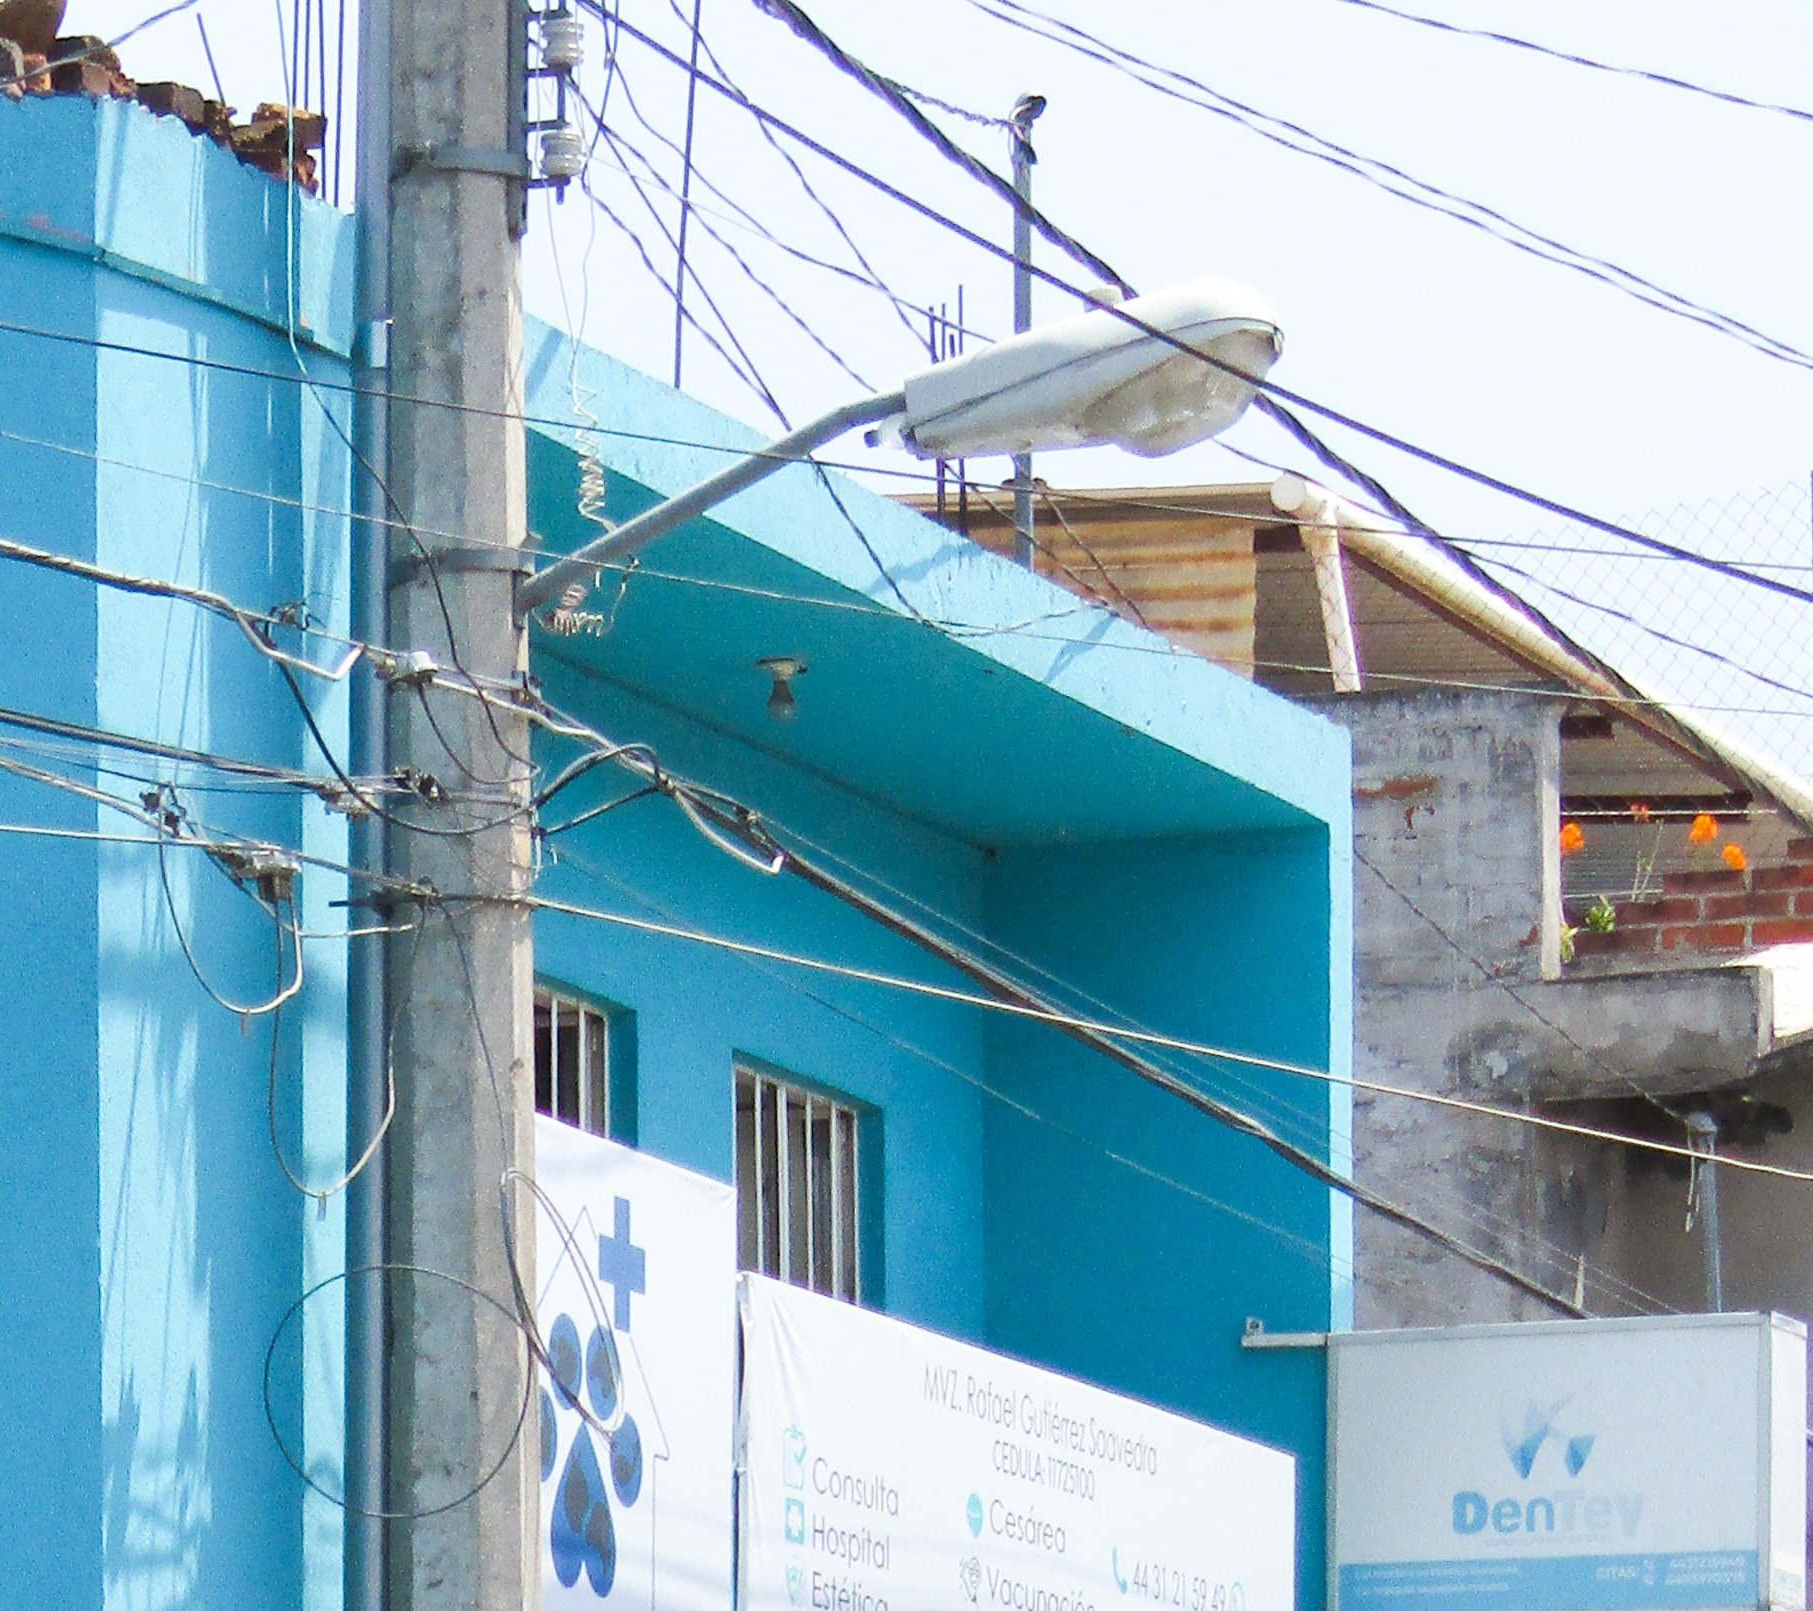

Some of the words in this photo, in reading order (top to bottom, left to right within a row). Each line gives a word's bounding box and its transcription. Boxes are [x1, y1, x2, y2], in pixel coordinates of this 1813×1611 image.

[967, 1375, 1016, 1428] Rafael
[1020, 1393, 1086, 1452] Gutiérrez
[1089, 1417, 1157, 1475] Saavedra
[812, 1457, 899, 1517] Consulta
[812, 1513, 890, 1570] Hospital
[990, 1499, 1066, 1553] Cesárea
[1132, 1560, 1148, 1595] 44
[1152, 1564, 1166, 1602] 31
[1172, 1570, 1186, 1608] 21
[1191, 1576, 1207, 1611] 59
